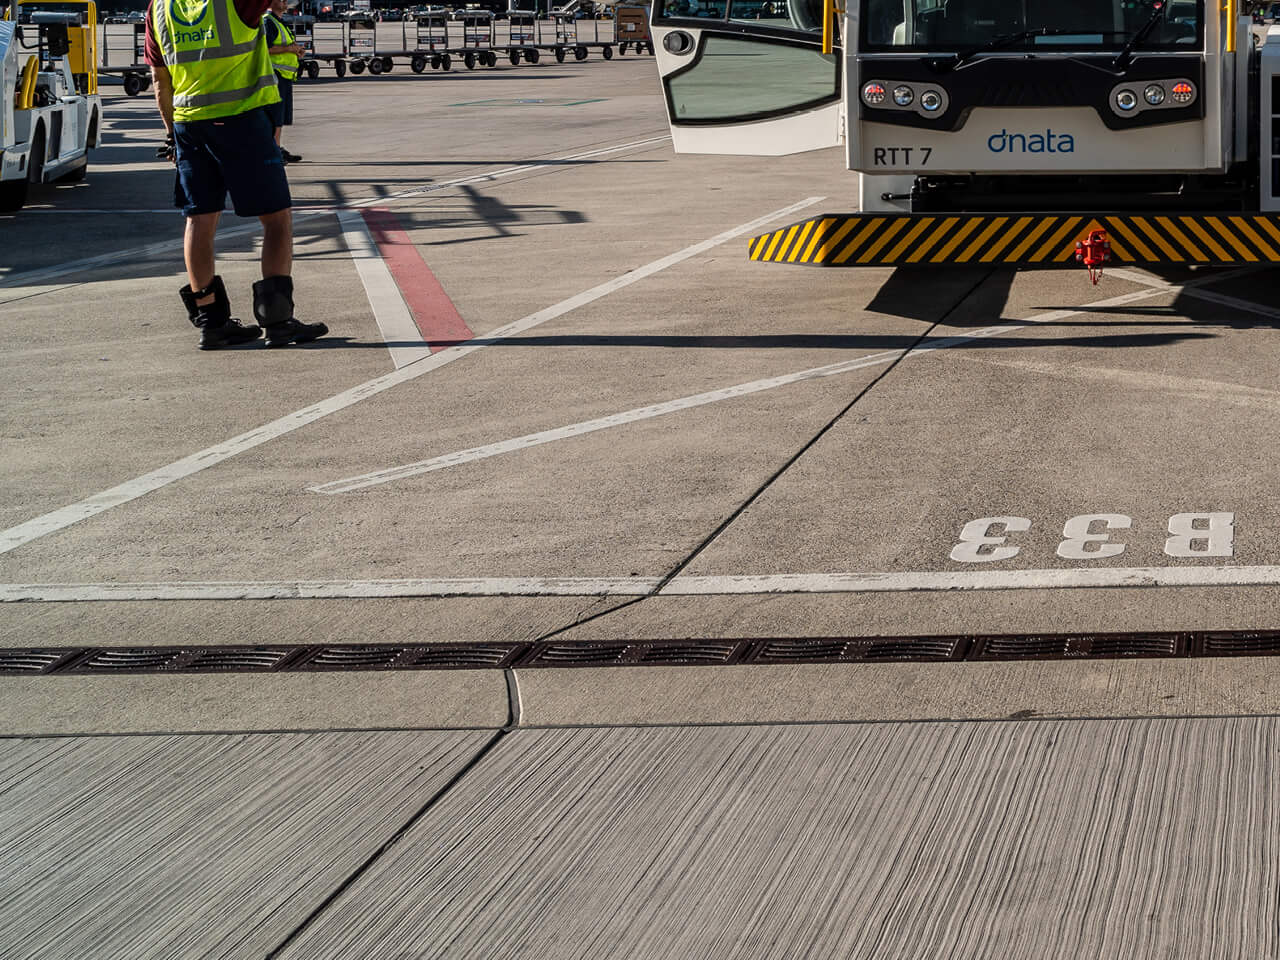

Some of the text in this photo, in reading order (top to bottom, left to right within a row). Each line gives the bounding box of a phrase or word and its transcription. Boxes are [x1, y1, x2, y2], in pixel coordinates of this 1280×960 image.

[987, 128, 1075, 153] dnata
[873, 147, 932, 166] RTT 7
[949, 511, 1236, 563] B33
